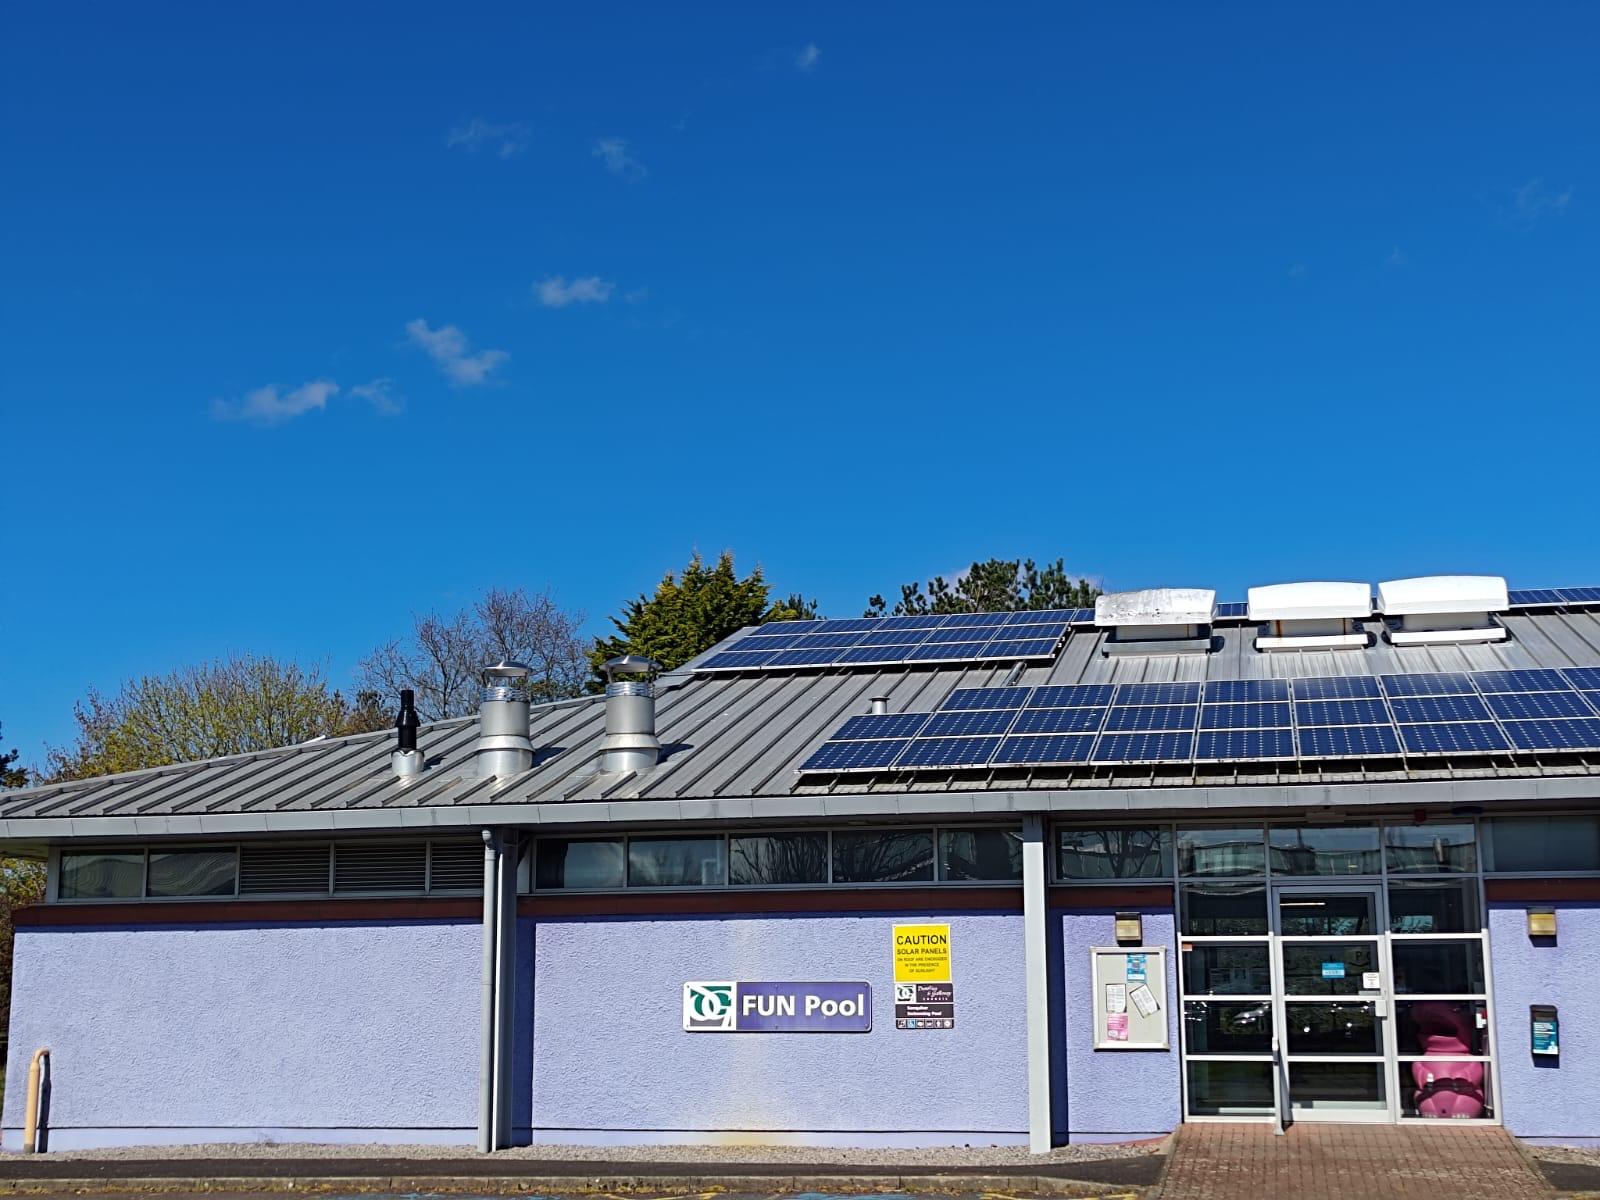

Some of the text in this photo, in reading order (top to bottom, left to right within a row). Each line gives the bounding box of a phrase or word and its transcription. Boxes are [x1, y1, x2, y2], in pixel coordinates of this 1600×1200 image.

[896, 934, 947, 945] CAUTION
[921, 947, 947, 955] PANELS
[743, 994, 795, 1016] FUN
[805, 994, 864, 1017] Pool
